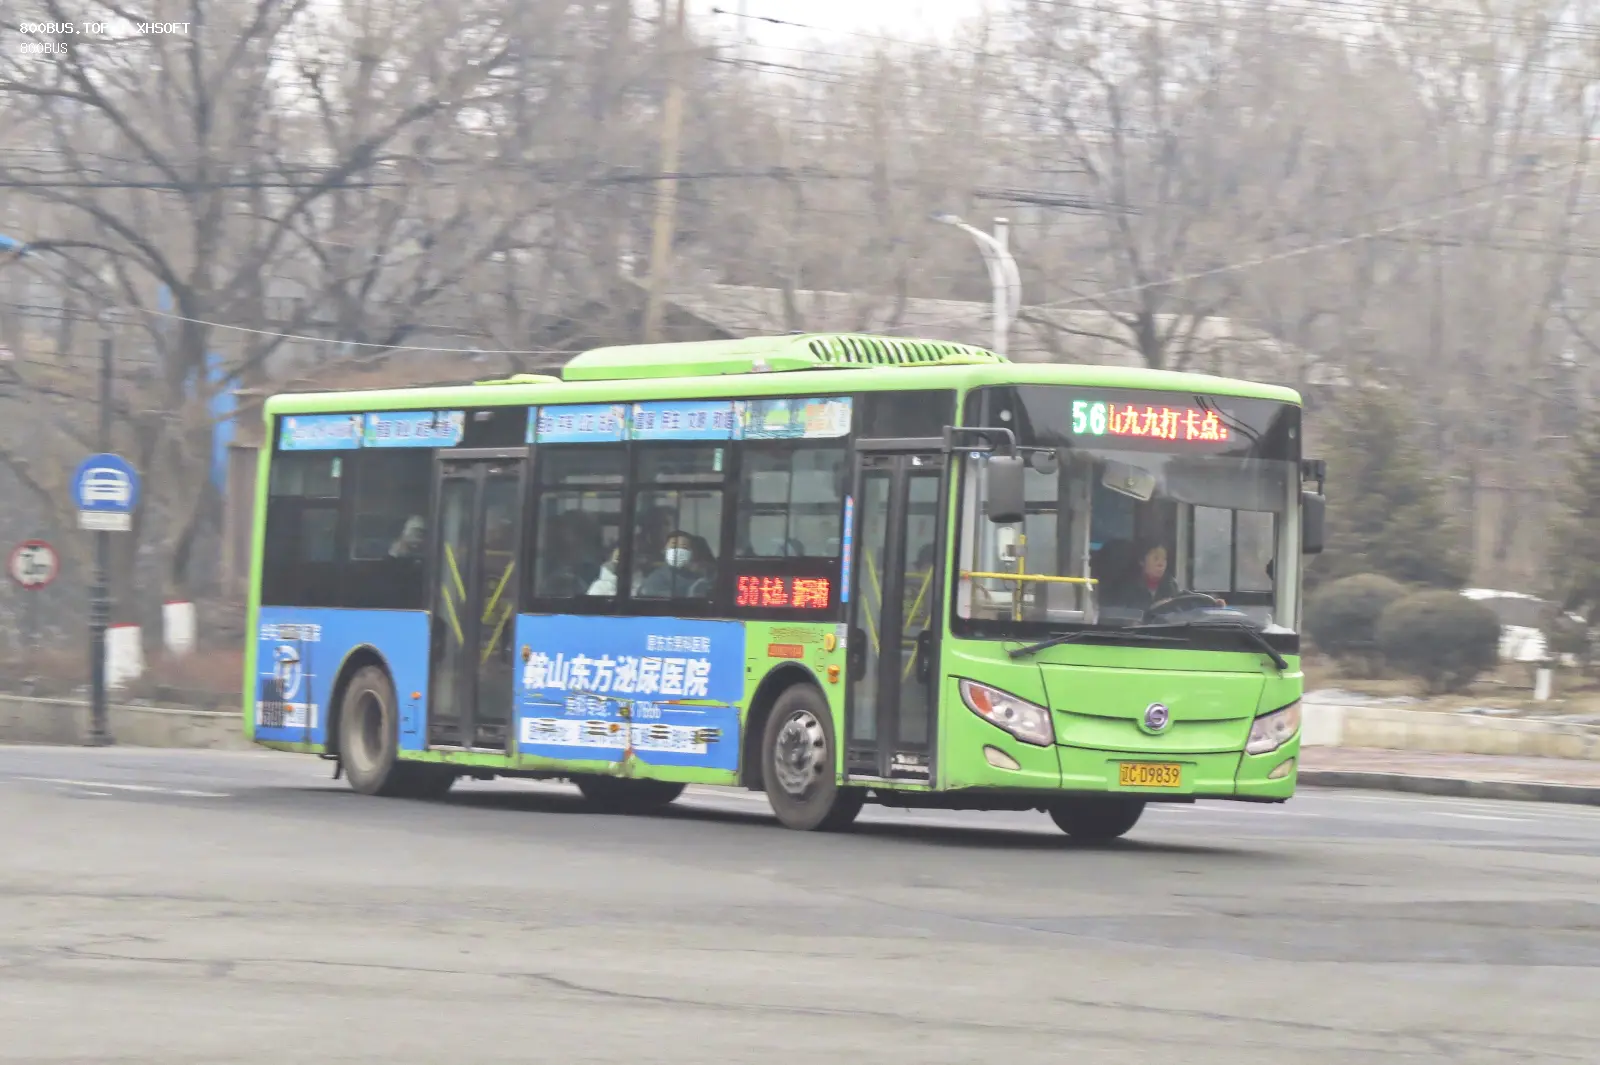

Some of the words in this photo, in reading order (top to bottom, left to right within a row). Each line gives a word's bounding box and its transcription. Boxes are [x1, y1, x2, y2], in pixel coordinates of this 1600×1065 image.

[1072, 400, 1106, 435] 56
[522, 651, 711, 696] 鞍山东方泌尿医院
